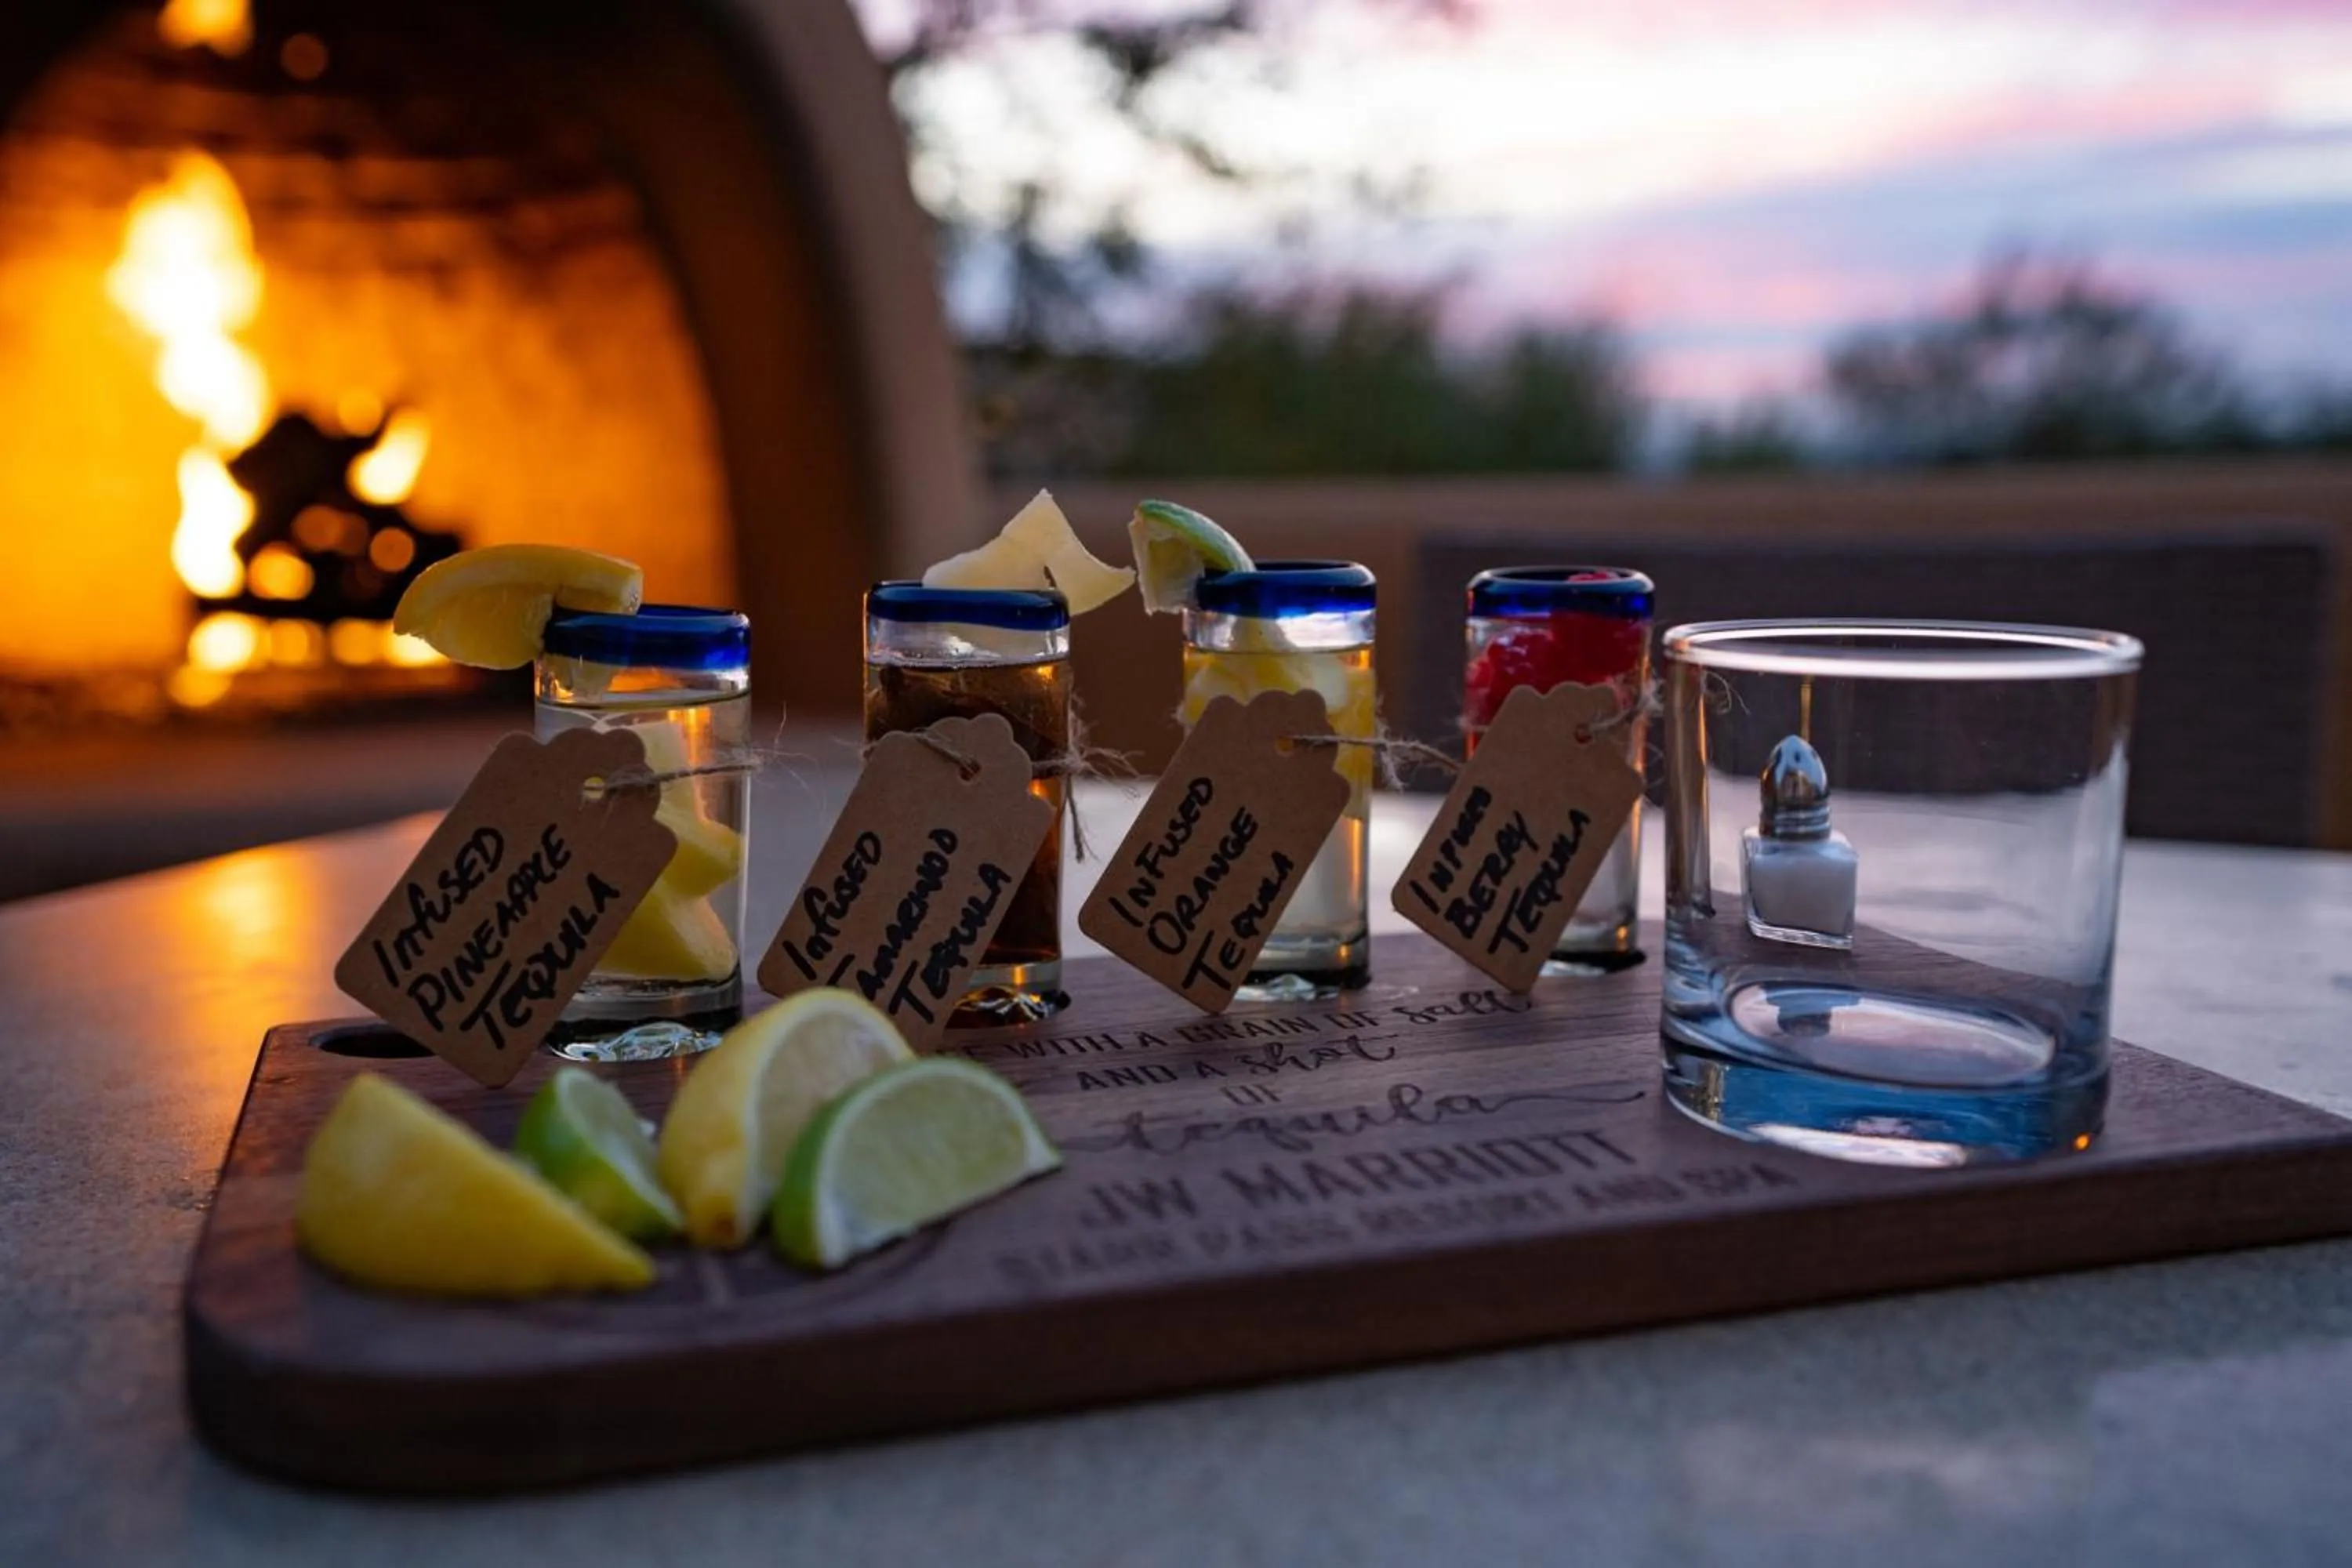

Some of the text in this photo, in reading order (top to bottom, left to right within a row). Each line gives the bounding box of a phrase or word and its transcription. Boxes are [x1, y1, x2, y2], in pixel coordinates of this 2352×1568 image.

[1147, 806, 1258, 955] ORANGE
[1443, 810, 1540, 939] BERRY
[1004, 1033, 1123, 1058] WITH
[1134, 1031, 1168, 1048] A
[1175, 1017, 1320, 1044] GRAIN
[1323, 1011, 1380, 1029] OF
[1076, 1033, 1400, 1091] AND A shot
[1080, 1129, 1637, 1228] JW MARRIOTT
